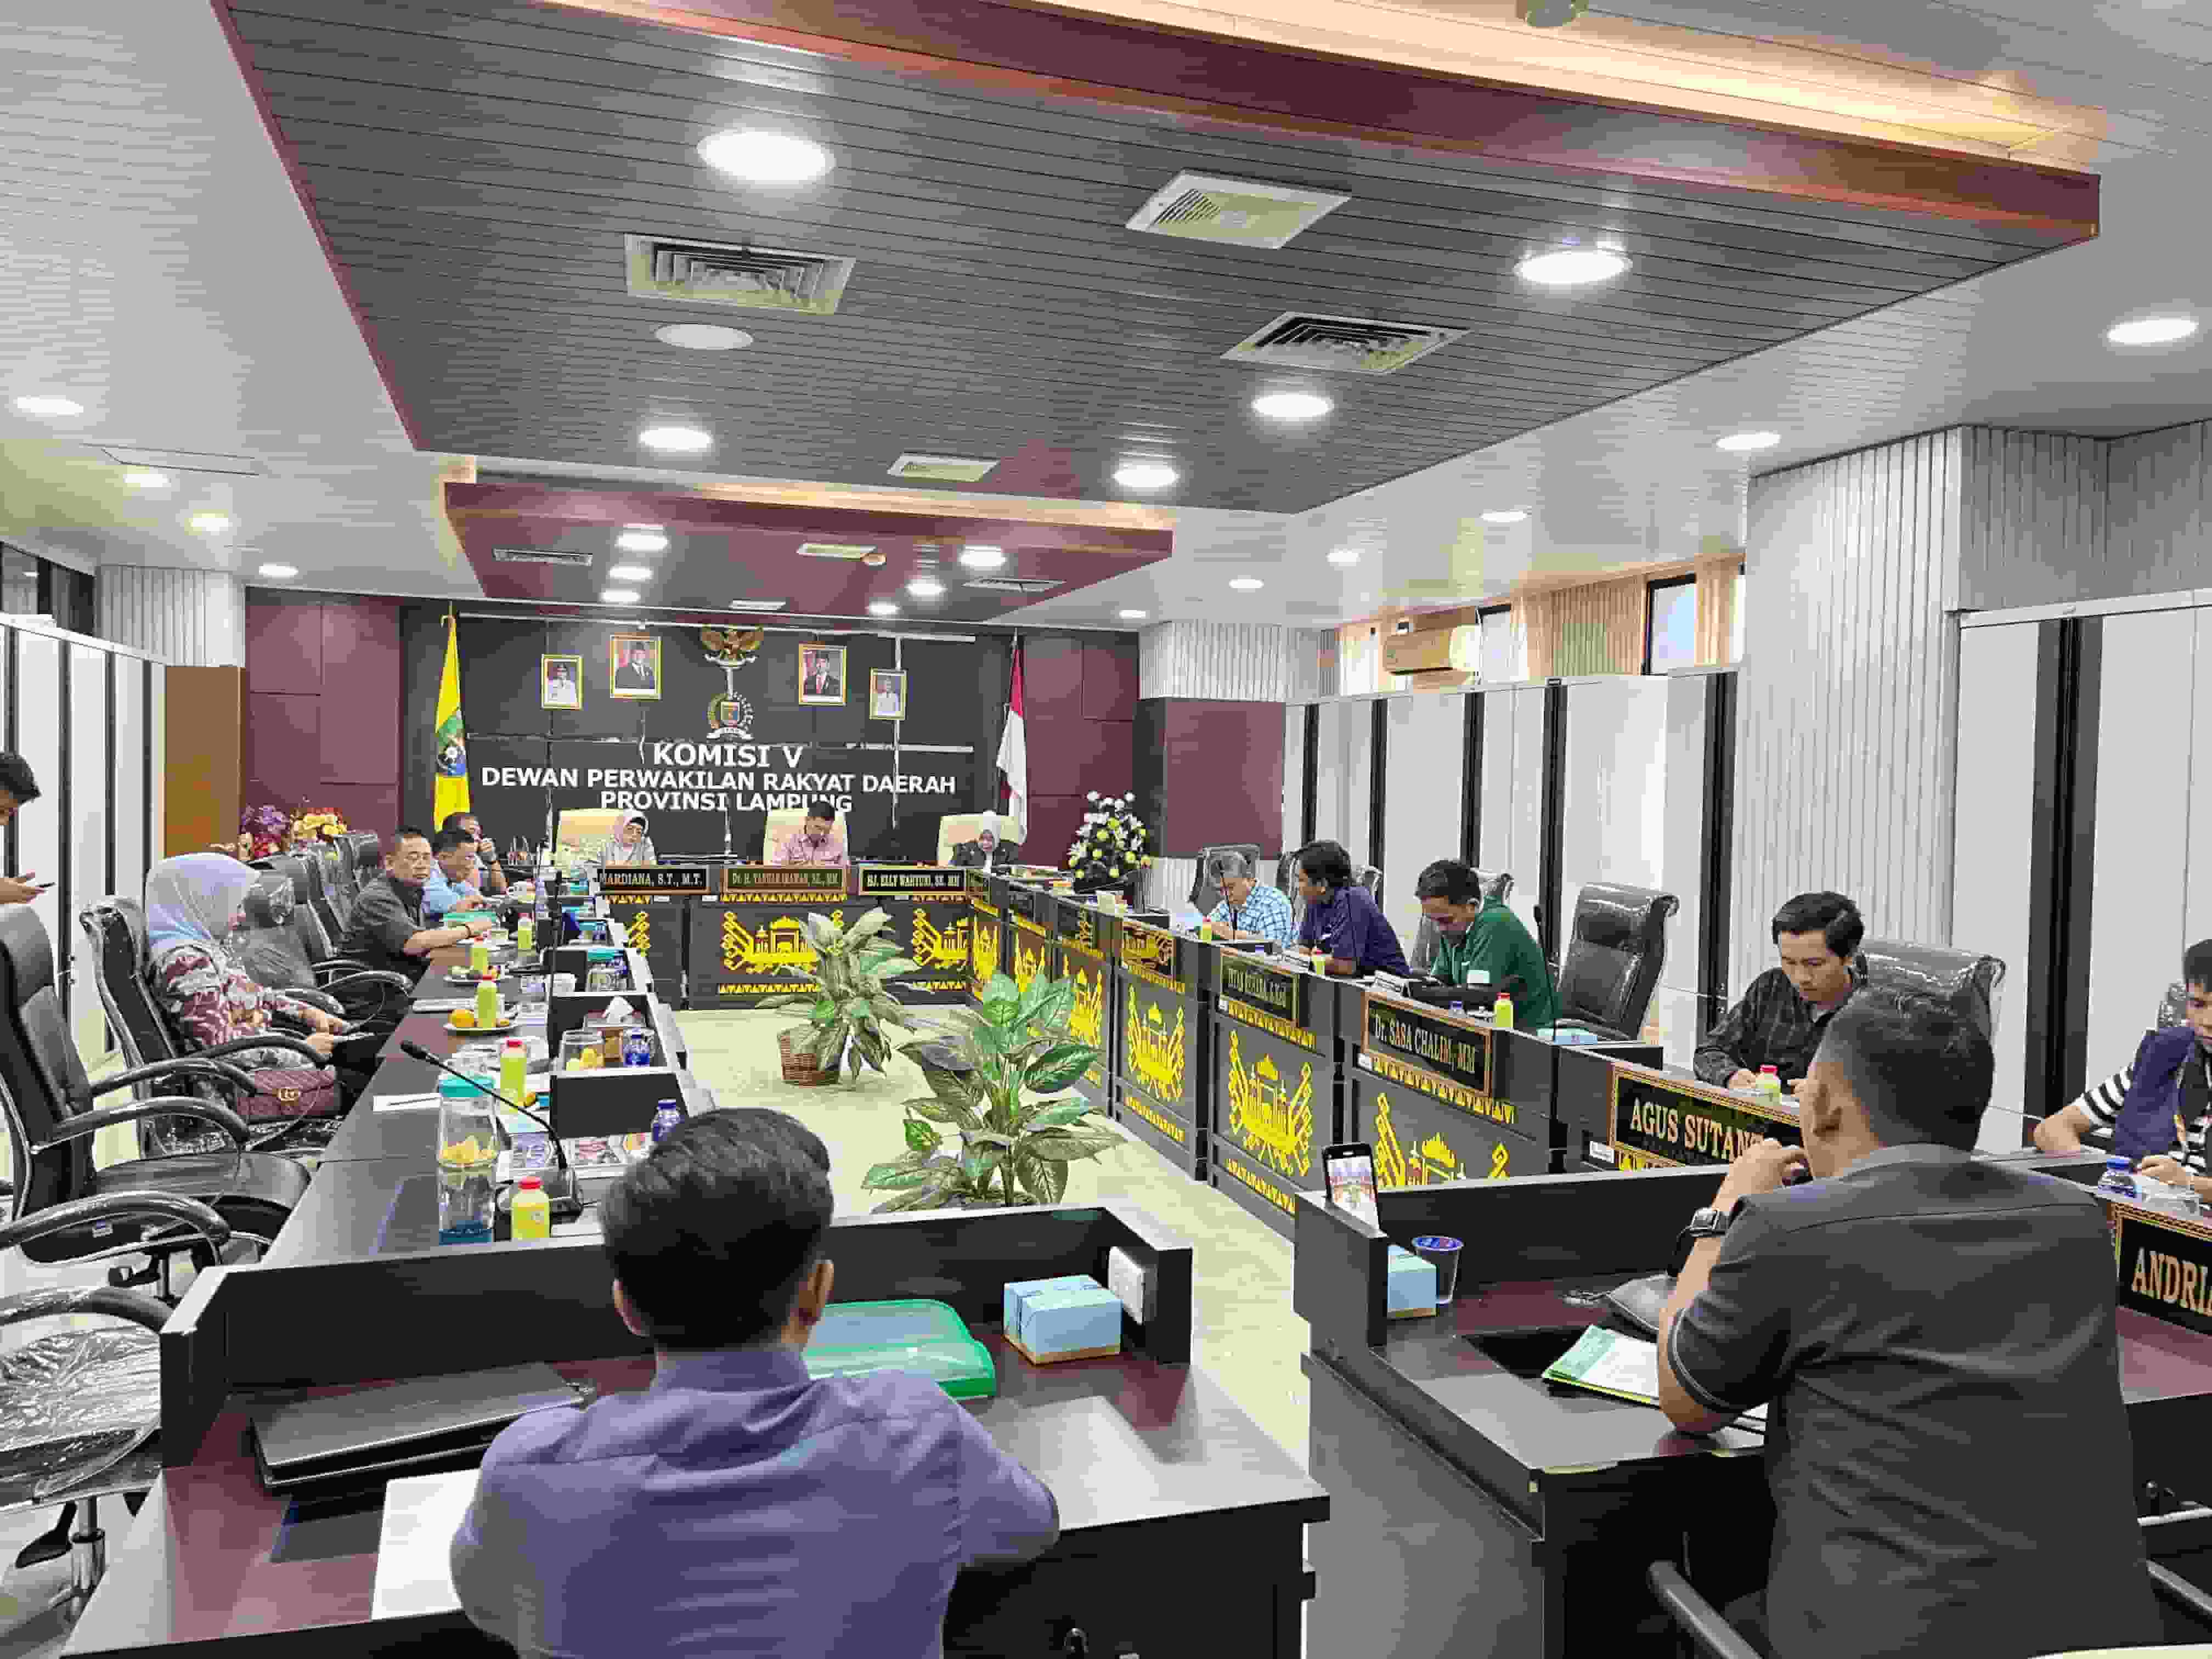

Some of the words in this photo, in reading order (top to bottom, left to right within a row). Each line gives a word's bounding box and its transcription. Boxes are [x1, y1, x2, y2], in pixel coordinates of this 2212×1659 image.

[653, 743, 770, 766] KOMISI
[782, 746, 803, 768] V
[482, 768, 578, 787] DEWAN
[588, 769, 754, 790] PERWAKILAN
[764, 773, 855, 792] RAKYAT
[863, 775, 956, 794] DAERAH
[601, 791, 727, 811] PROVINSI
[1390, 1018, 1413, 1052] SASA
[1630, 1097, 1679, 1142] AGUS
